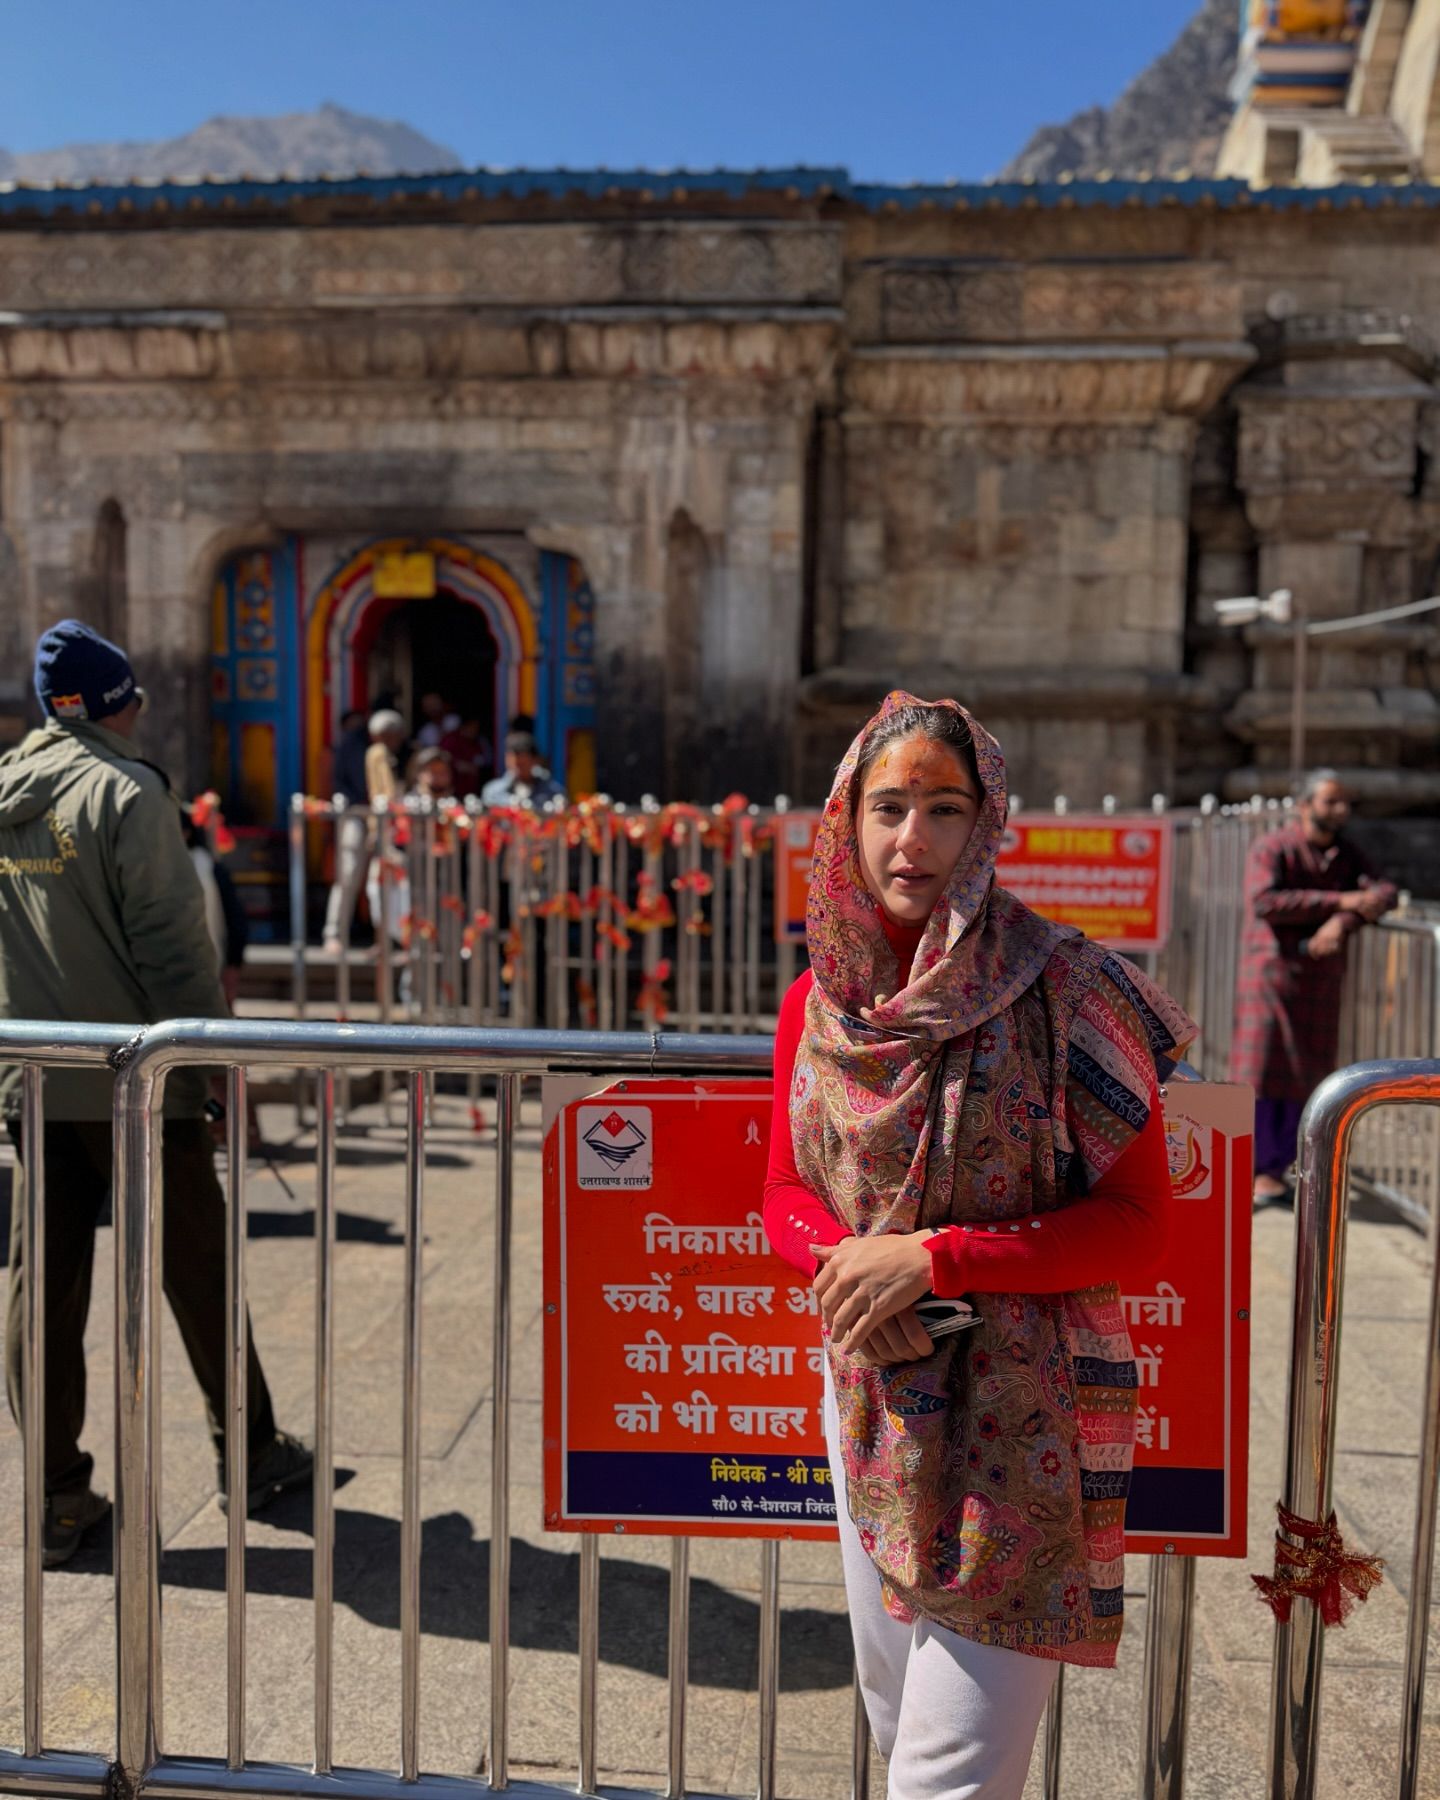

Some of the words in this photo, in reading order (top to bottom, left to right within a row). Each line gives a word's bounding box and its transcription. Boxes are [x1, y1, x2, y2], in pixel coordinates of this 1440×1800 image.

[642, 1212, 771, 1255] निकासी
[696, 1286, 775, 1316] बाहर
[1121, 1281, 1186, 1326] ात्री
[624, 1329, 672, 1374] की
[681, 1331, 797, 1378] प्रतिक्षा
[614, 1391, 663, 1433] को
[673, 1390, 718, 1434] भी
[728, 1406, 807, 1438] बाहर
[711, 1457, 767, 1483] निवेदक
[786, 1459, 808, 1484] श्री
